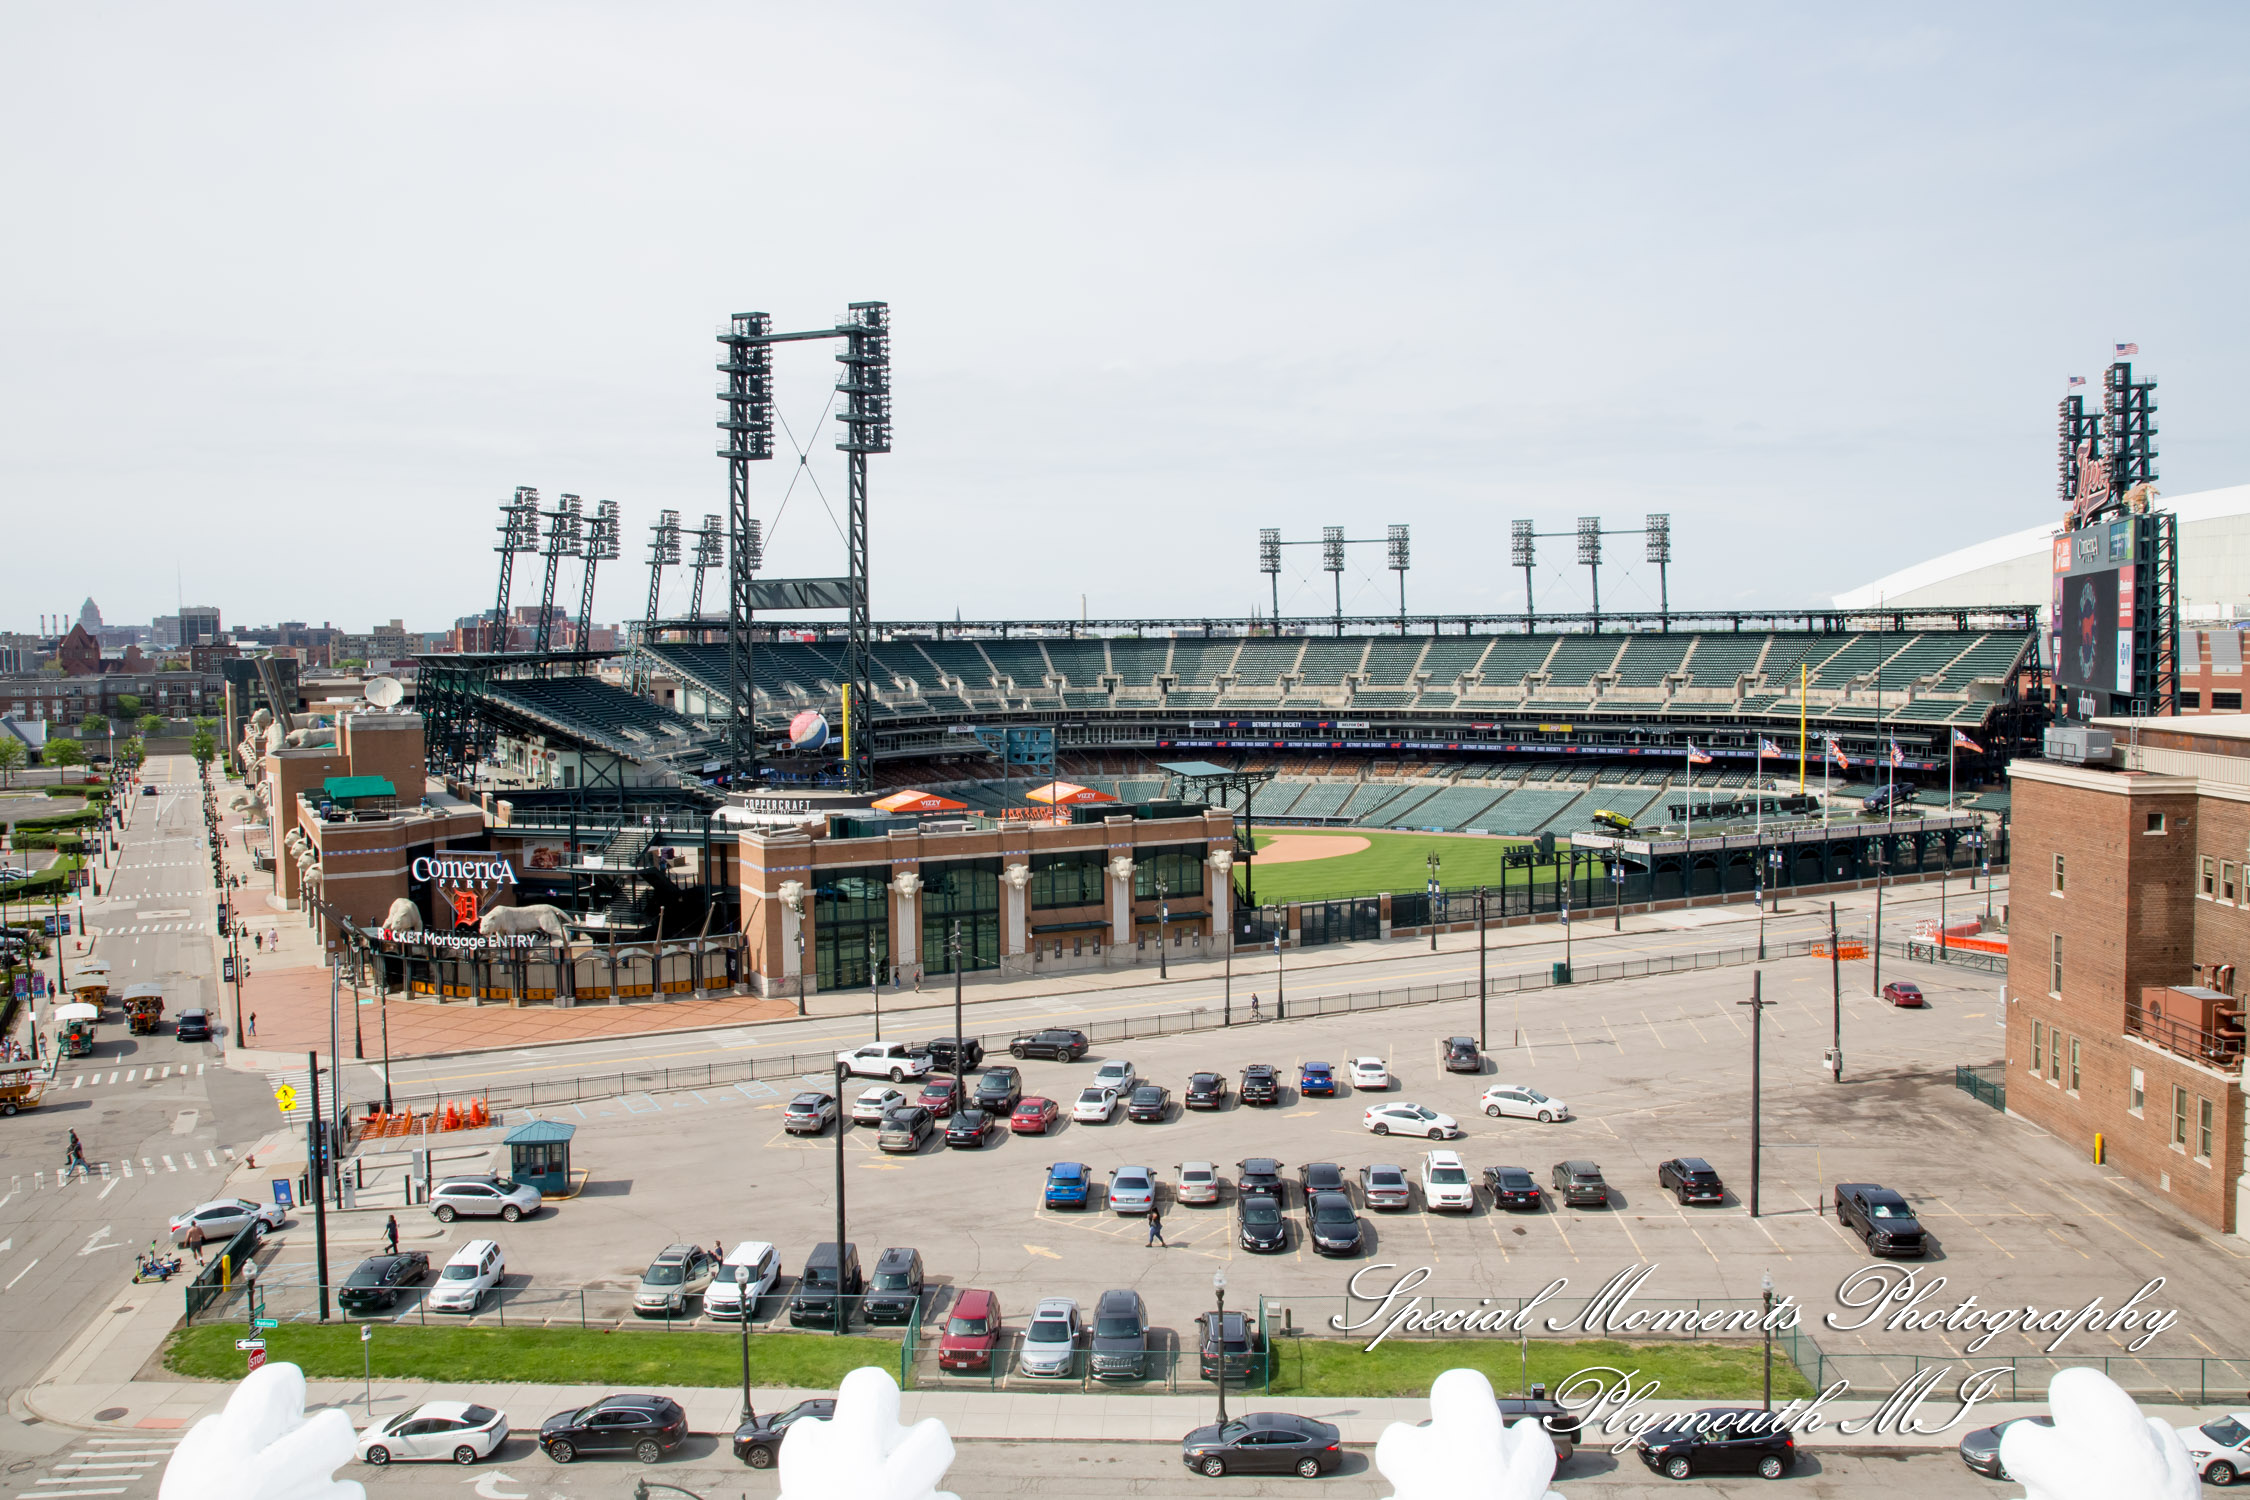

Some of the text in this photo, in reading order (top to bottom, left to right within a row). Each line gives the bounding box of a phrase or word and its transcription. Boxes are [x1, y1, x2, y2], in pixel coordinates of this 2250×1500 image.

[744, 799, 811, 811] COPPERCRAFT
[439, 879, 489, 889] PARK
[377, 928, 536, 950] ROCKET Mortgage ENTRY
[249, 1352, 266, 1368] STOP
